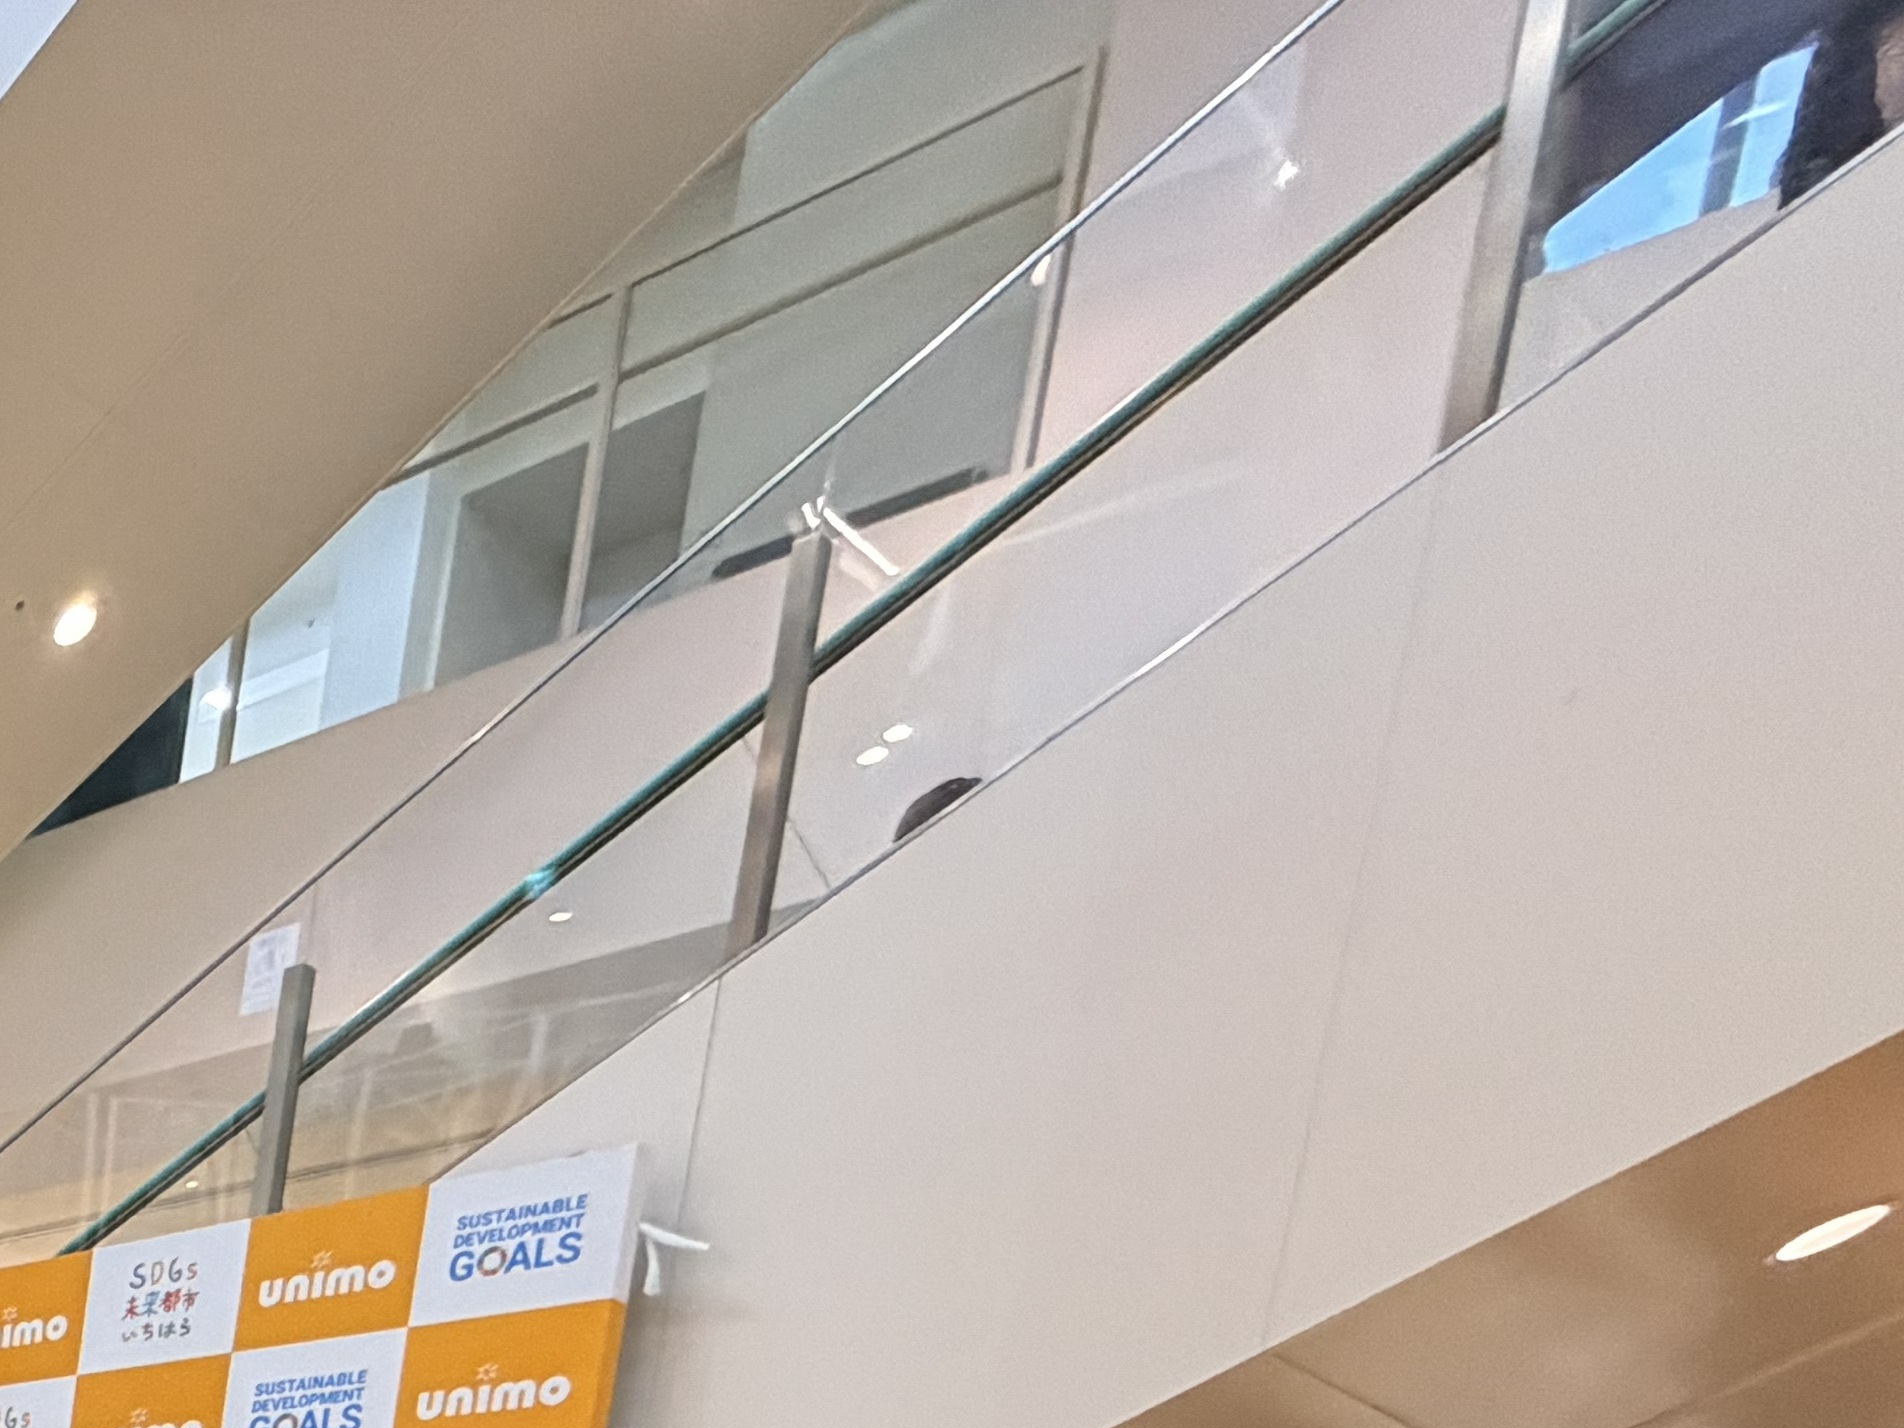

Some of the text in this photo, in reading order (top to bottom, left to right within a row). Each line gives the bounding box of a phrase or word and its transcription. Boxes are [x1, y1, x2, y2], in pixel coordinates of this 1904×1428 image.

[453, 1212, 586, 1249] DEVELOPMENT
[456, 1193, 588, 1231] SUSTAINABLE
[128, 1256, 200, 1289] SDGs
[448, 1231, 583, 1282] GOALS
[258, 1259, 395, 1308] unimo
[121, 1288, 200, 1321] 未来都市
[251, 1387, 365, 1413] DEVELOPMENT
[254, 1369, 368, 1398] SUSTAINABLE
[416, 1375, 571, 1421] unimo
